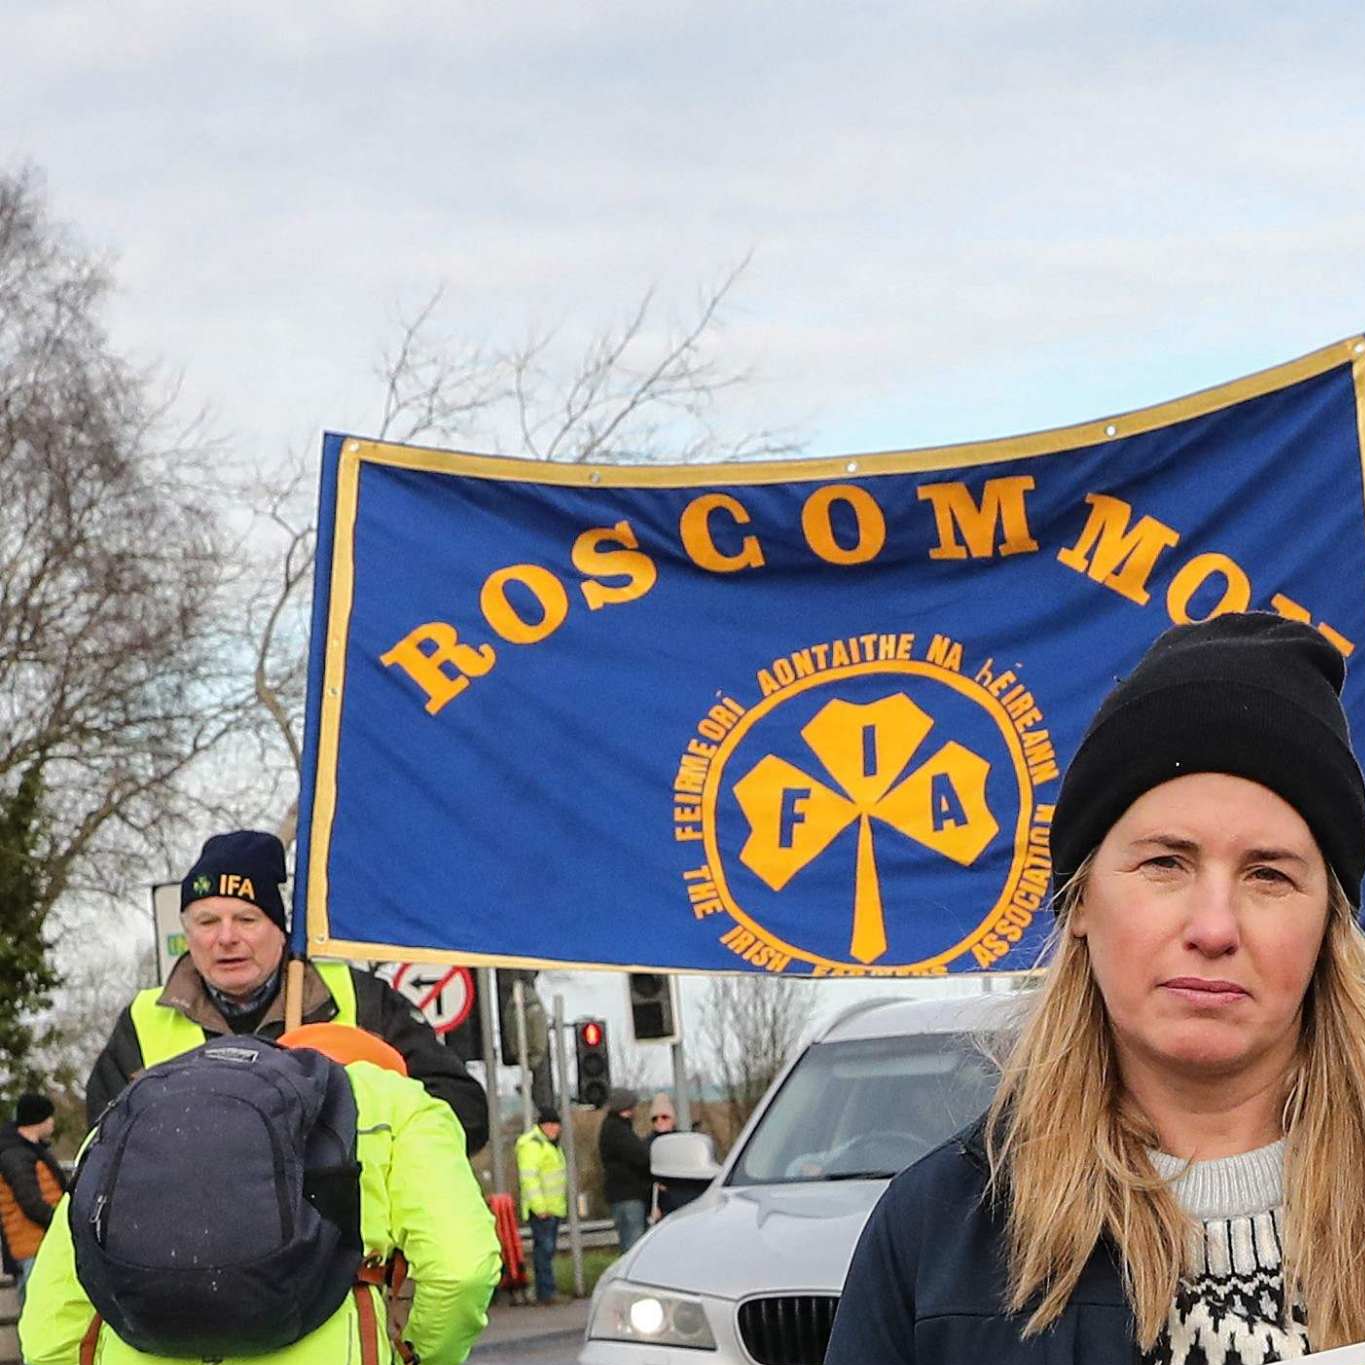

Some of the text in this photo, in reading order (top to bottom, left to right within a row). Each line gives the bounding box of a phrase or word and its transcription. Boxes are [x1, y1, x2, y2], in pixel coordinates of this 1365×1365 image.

[379, 473, 1355, 716] ROSCOMMO
[755, 633, 915, 697] AONTAITHE
[926, 633, 964, 672] NA
[219, 874, 255, 900] IFA
[683, 865, 793, 973] THE IRISH
[970, 803, 1057, 969] ASSOCIATION
